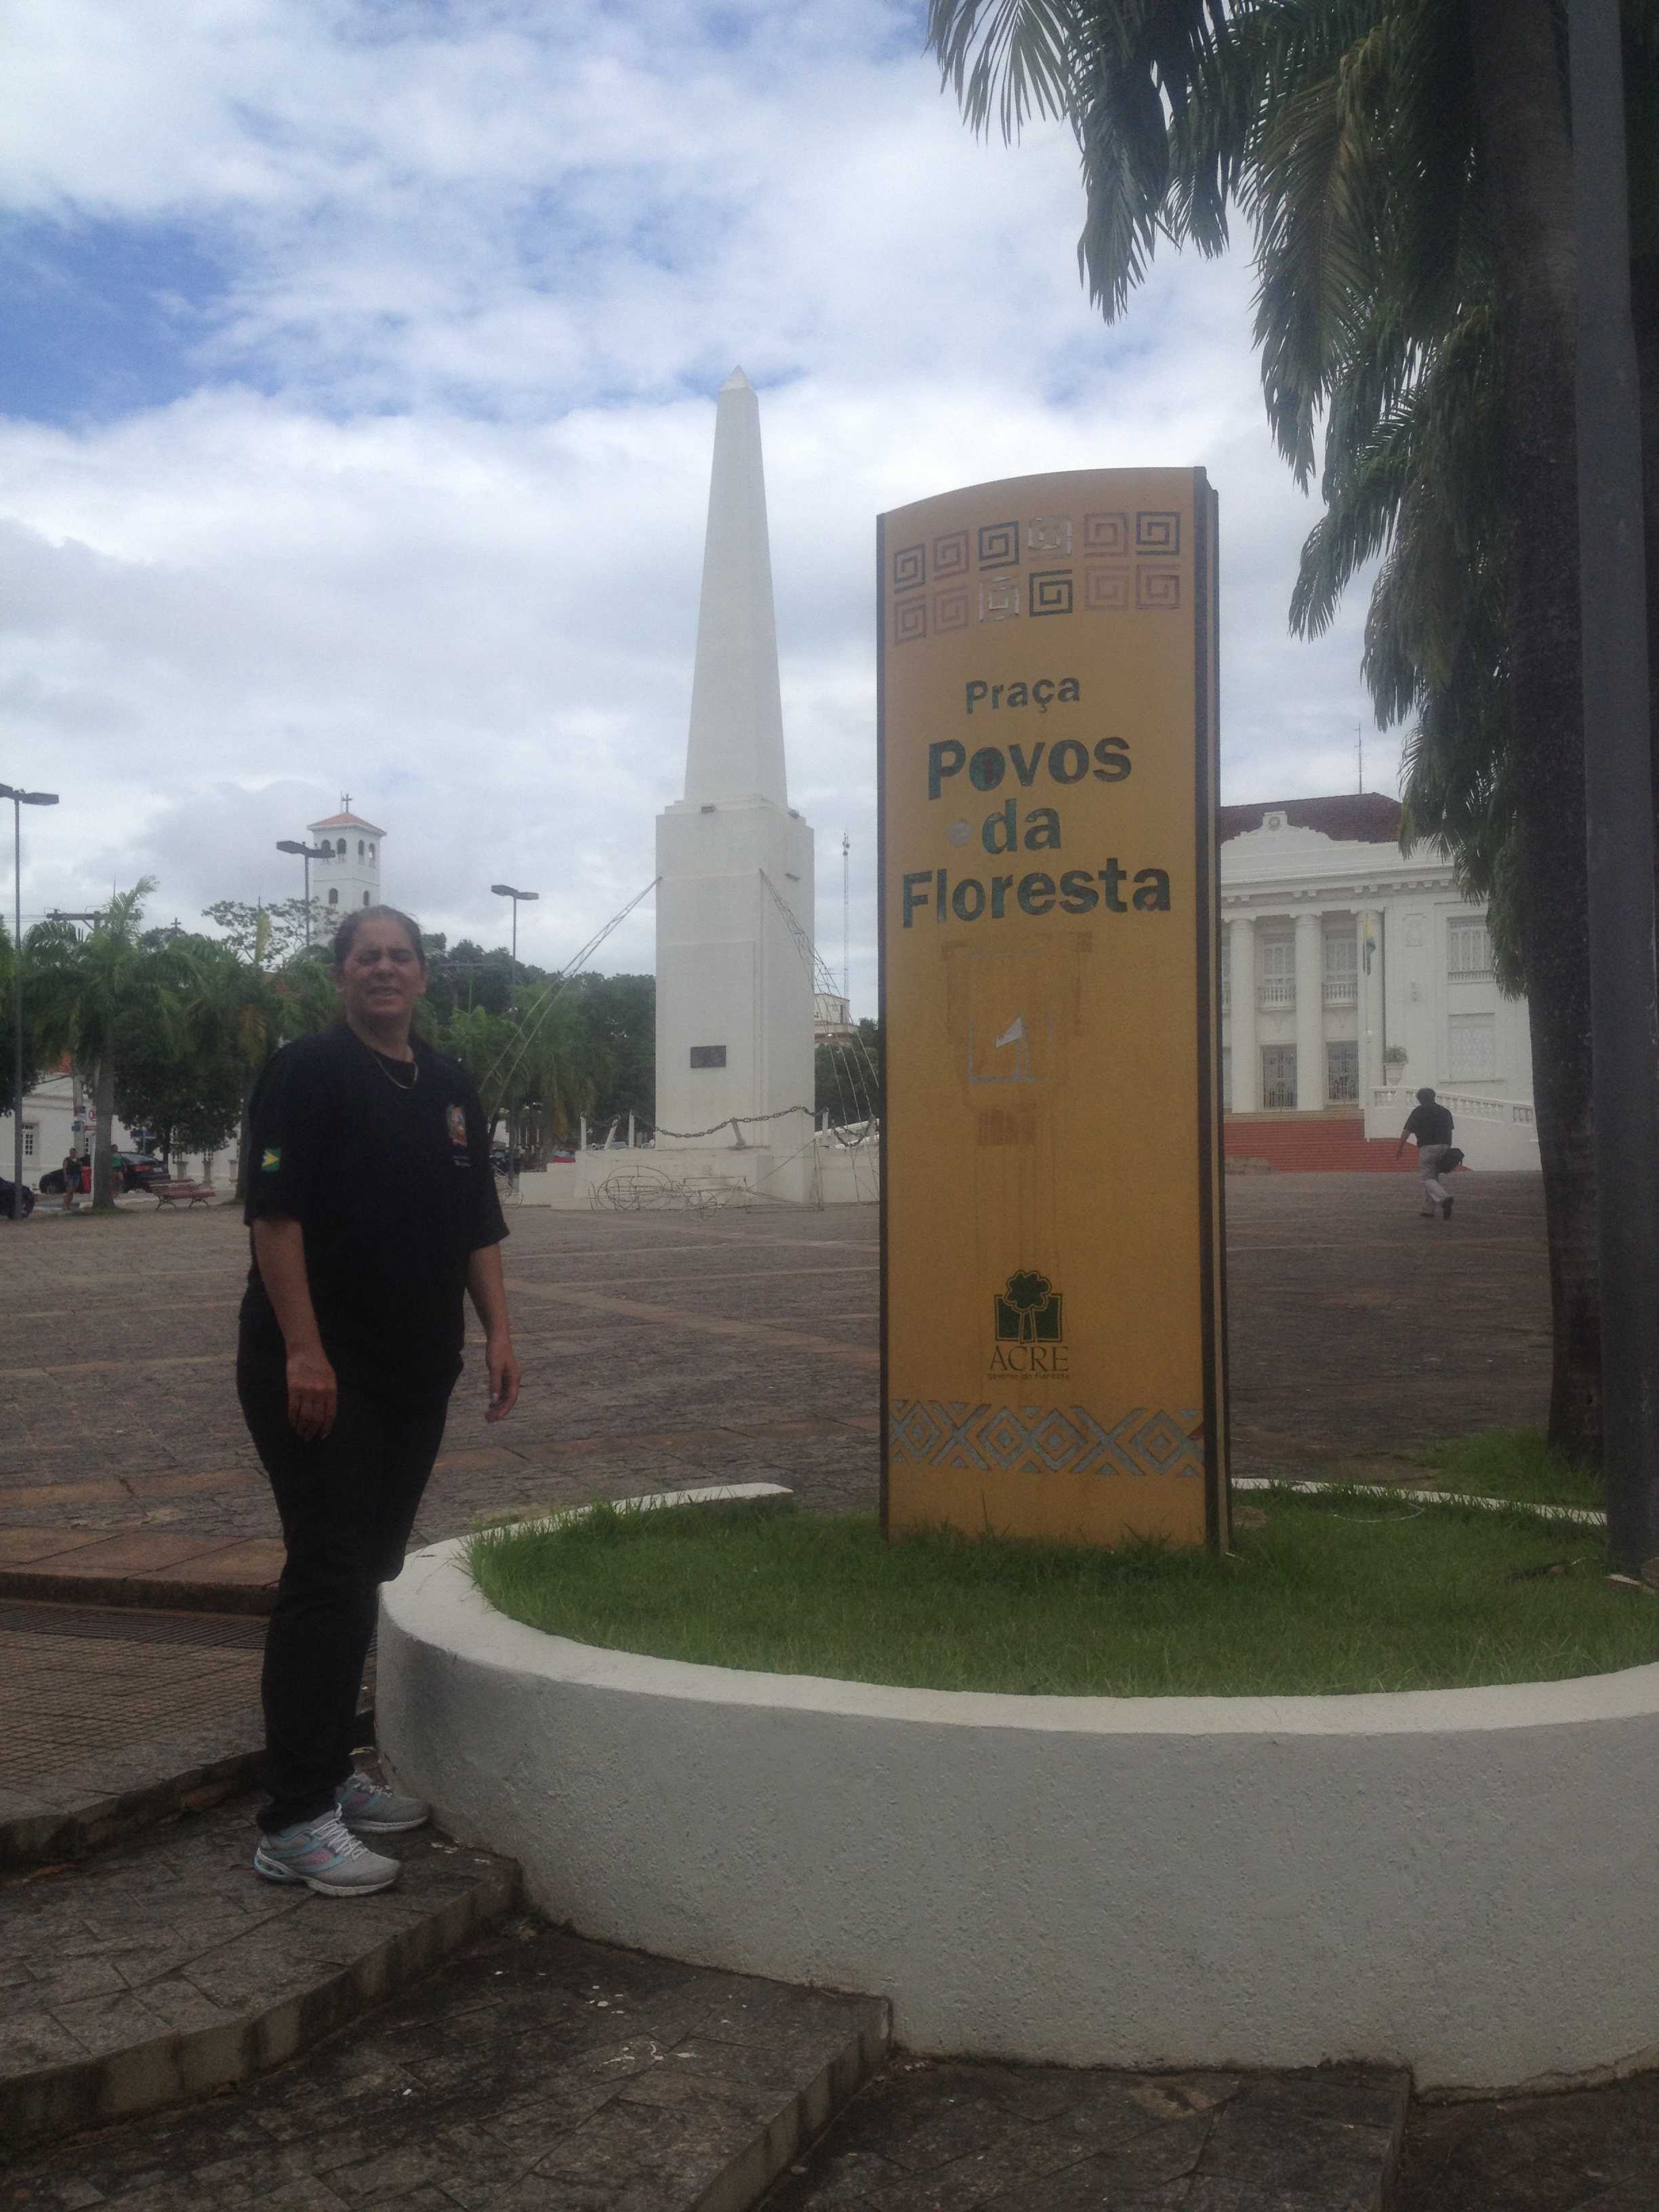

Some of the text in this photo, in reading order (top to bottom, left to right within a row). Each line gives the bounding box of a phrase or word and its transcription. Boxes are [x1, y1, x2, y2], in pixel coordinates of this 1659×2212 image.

[965, 677, 1080, 714] Praça
[928, 737, 1132, 800] Povos
[981, 798, 1061, 855] da
[903, 857, 1171, 928] Floresta
[990, 1345, 1069, 1372] ACRE
